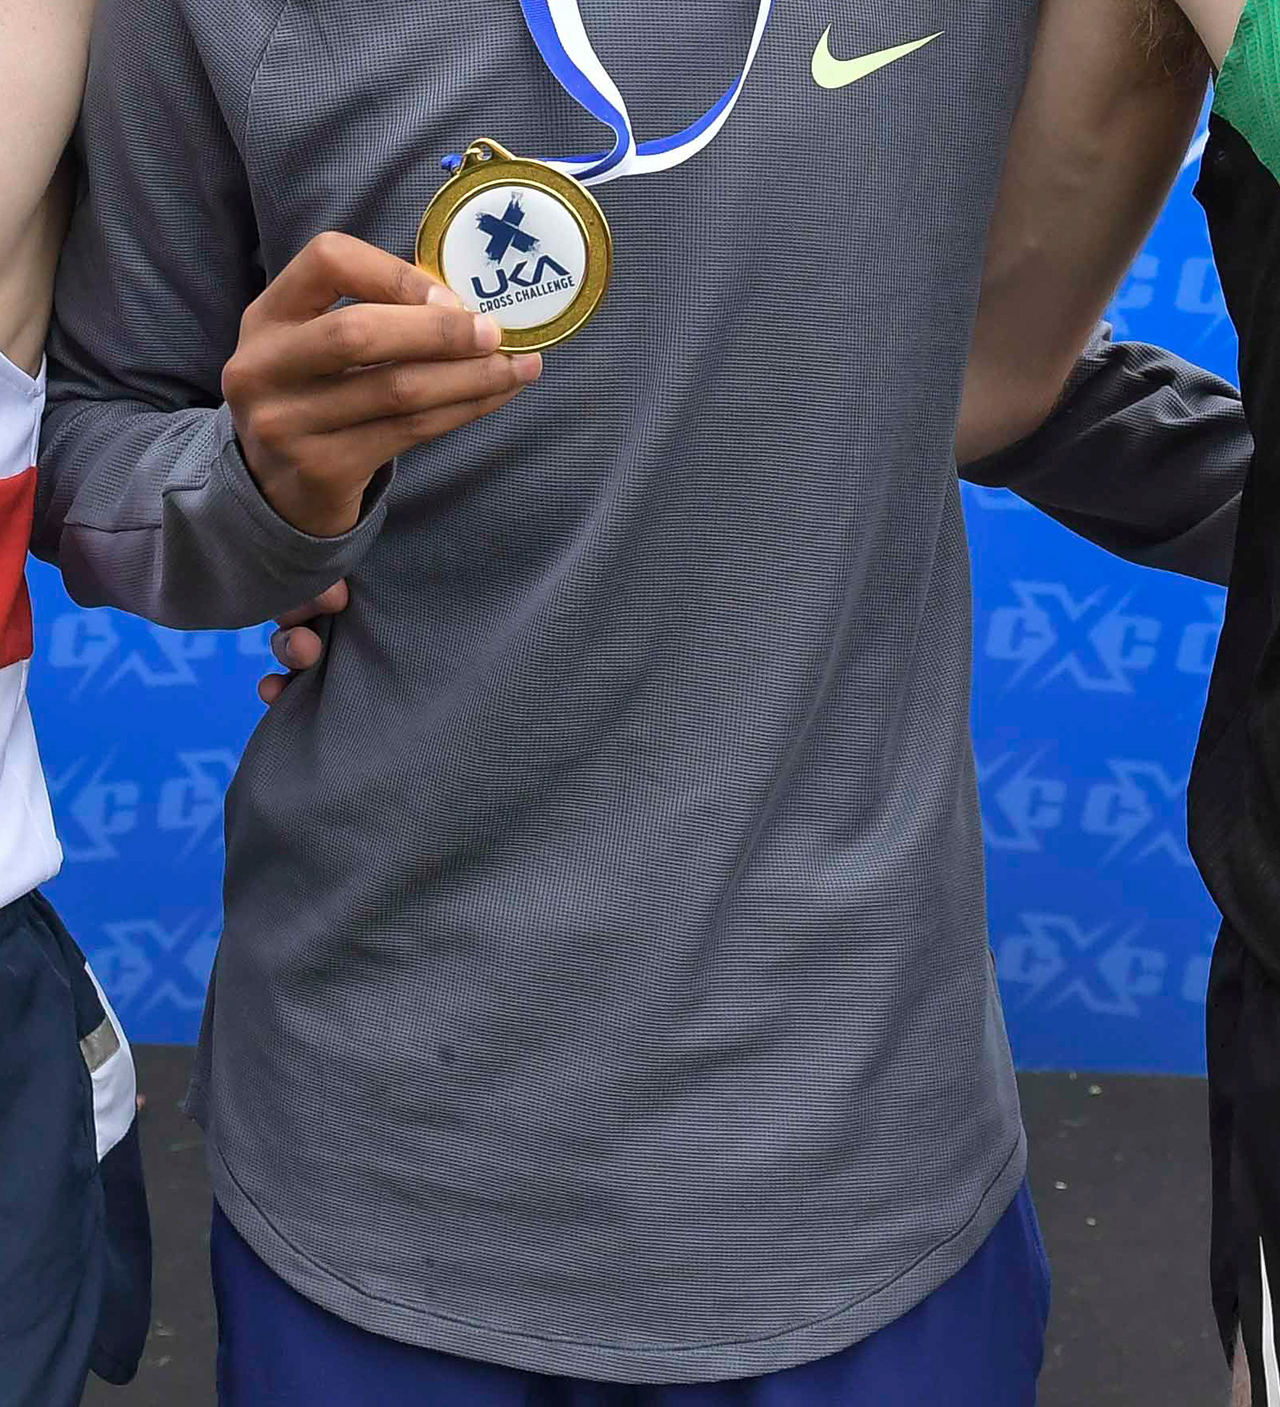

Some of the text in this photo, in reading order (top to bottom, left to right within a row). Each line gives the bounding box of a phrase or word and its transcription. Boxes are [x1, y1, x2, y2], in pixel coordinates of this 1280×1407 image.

[471, 255, 570, 299] UKA
[479, 275, 575, 313] CROSS CHALLENGE
[986, 581, 1161, 692] CXC
